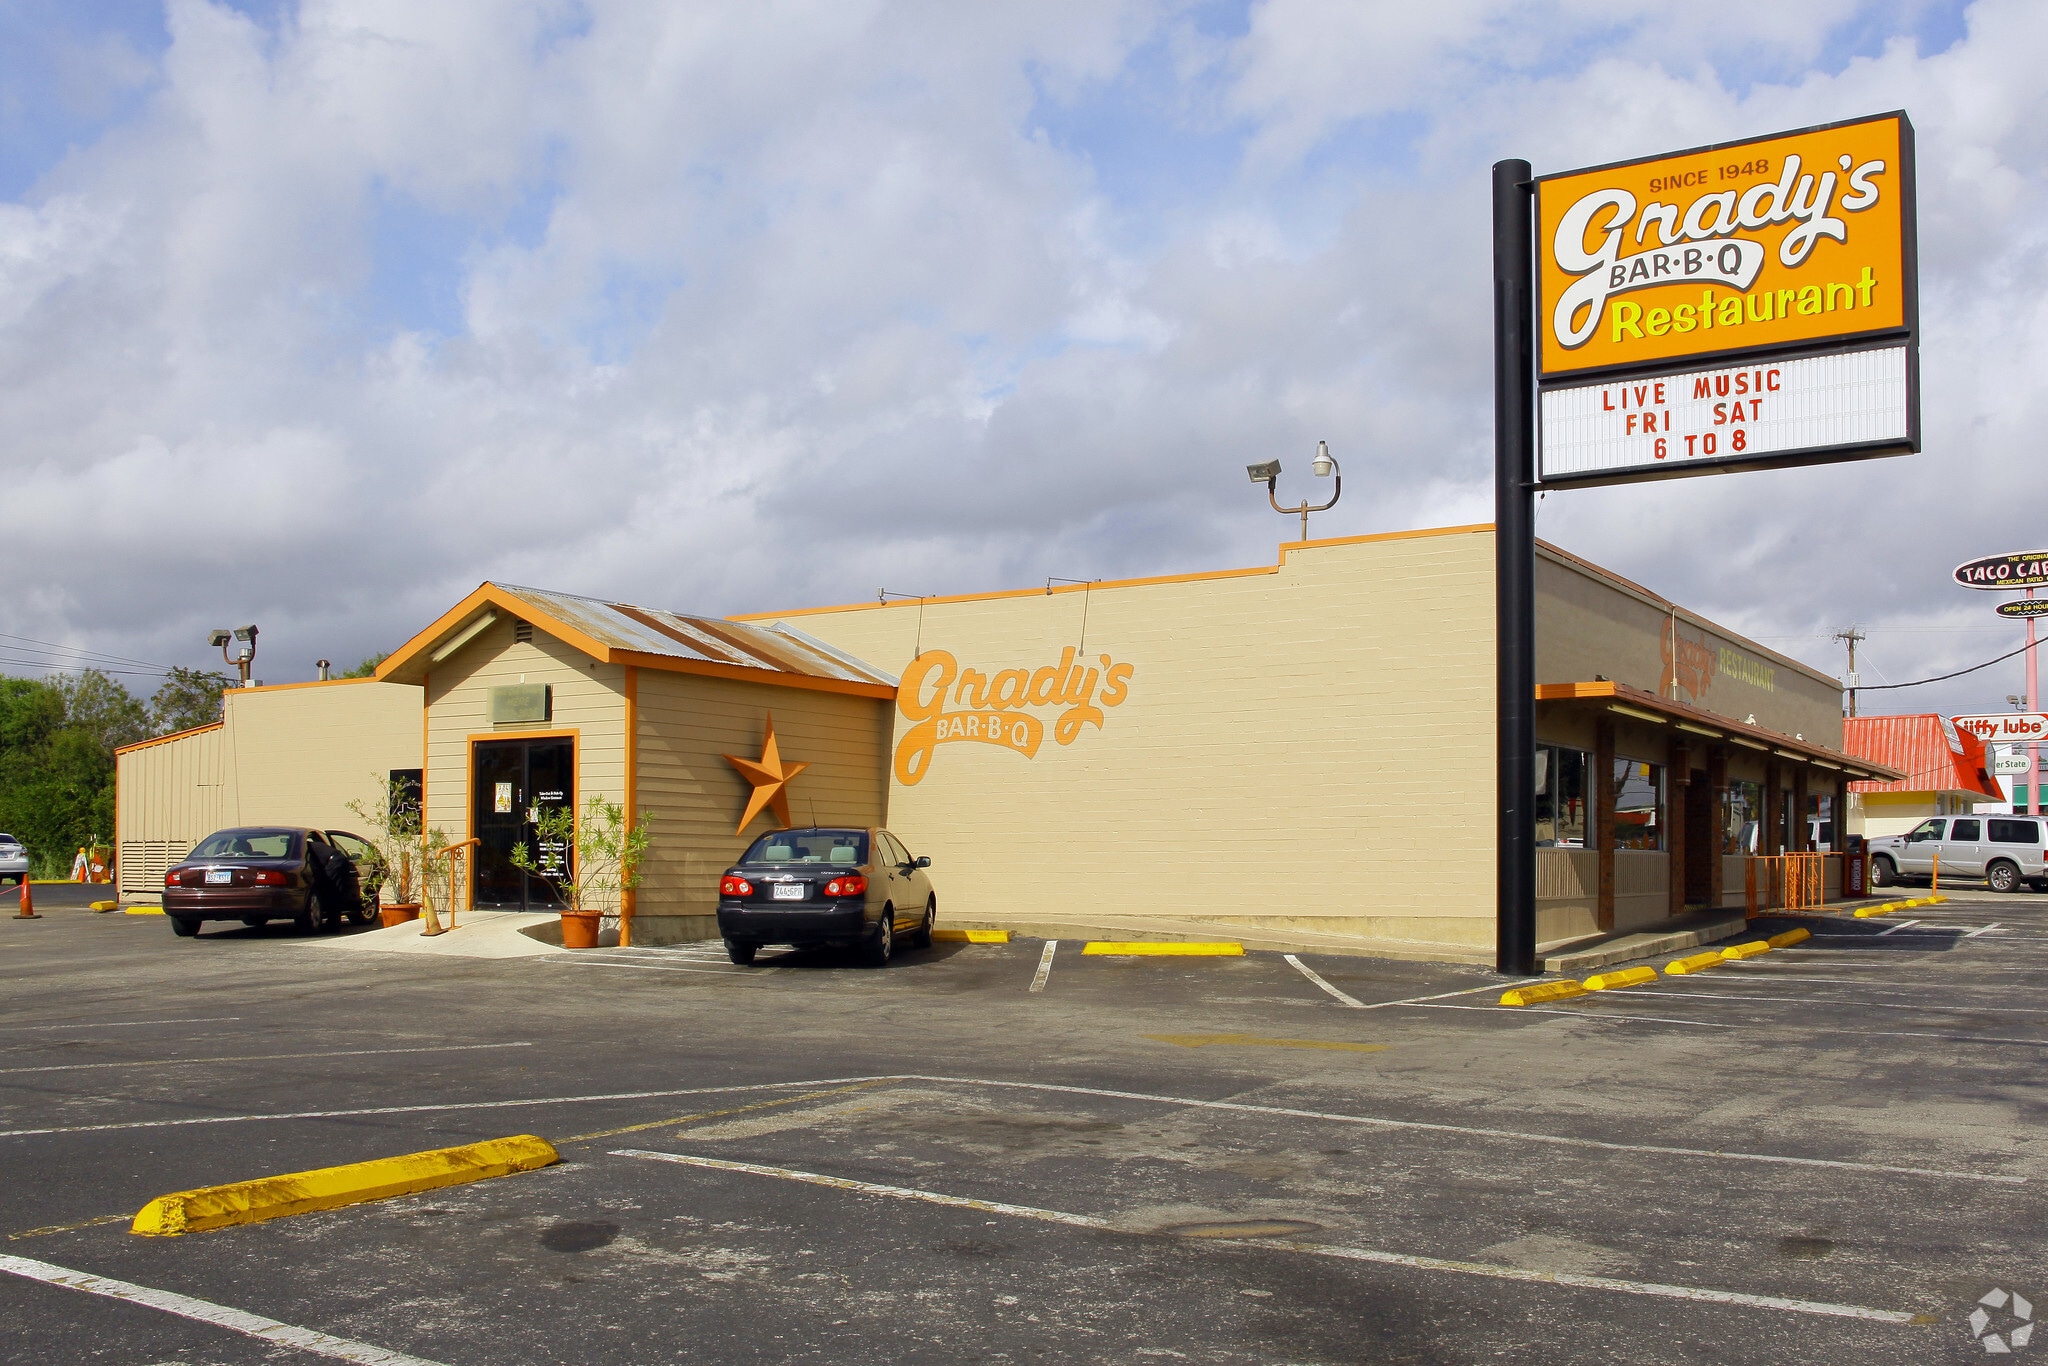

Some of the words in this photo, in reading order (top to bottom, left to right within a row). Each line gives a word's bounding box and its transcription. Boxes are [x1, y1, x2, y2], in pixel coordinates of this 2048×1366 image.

[1649, 169, 1708, 193] SINCE
[1718, 158, 1769, 182] 1948
[1553, 153, 1886, 350] Grady's
[1611, 266, 1877, 343] Restaurant
[1603, 382, 1666, 411] LIVE
[1693, 369, 1781, 399] MUSIC
[1626, 410, 1670, 435] FRI
[1713, 398, 1762, 425] SAT
[1654, 437, 1667, 459] 6
[1684, 432, 1717, 456] TO
[1731, 429, 1746, 451] 8
[1962, 564, 2011, 582] TACO
[1720, 647, 1775, 693] RESTAURANT
[894, 646, 1135, 786] Grady's
[2003, 718, 2042, 734] lube
